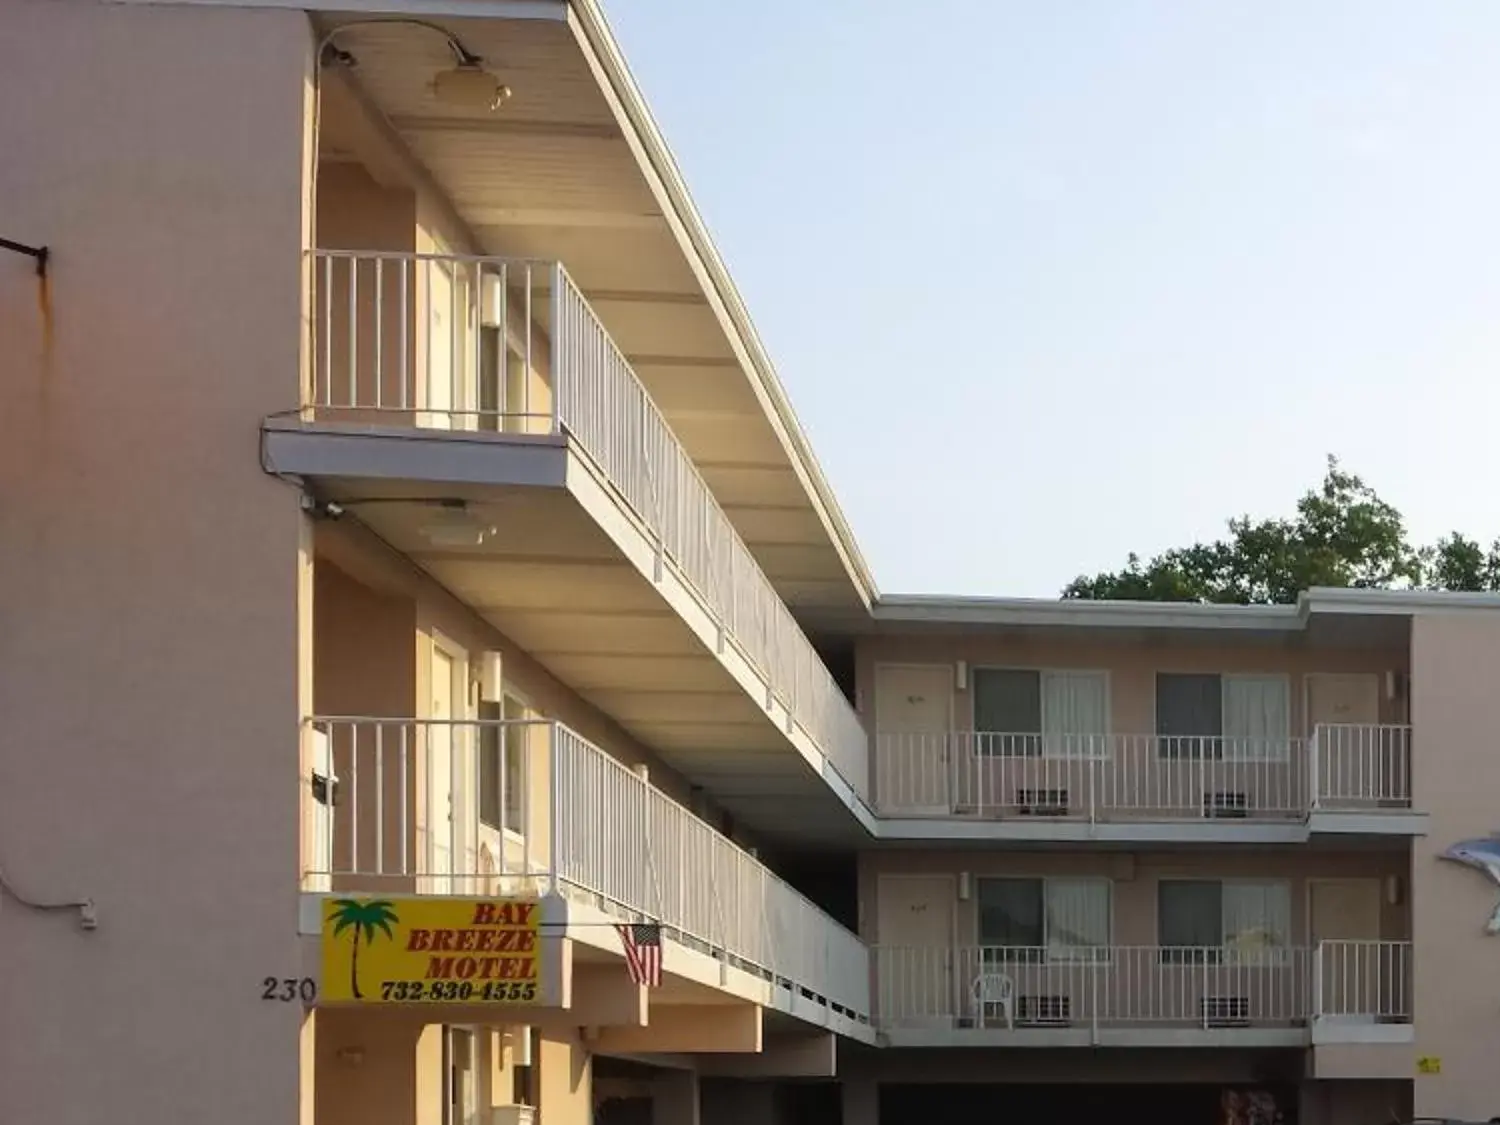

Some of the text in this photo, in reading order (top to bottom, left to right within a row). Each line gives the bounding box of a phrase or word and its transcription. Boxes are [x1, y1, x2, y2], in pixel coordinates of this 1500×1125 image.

[472, 902, 538, 925] BAY
[406, 928, 537, 952] BREEZE
[424, 955, 537, 979] MOTEL
[261, 976, 316, 1002] 230
